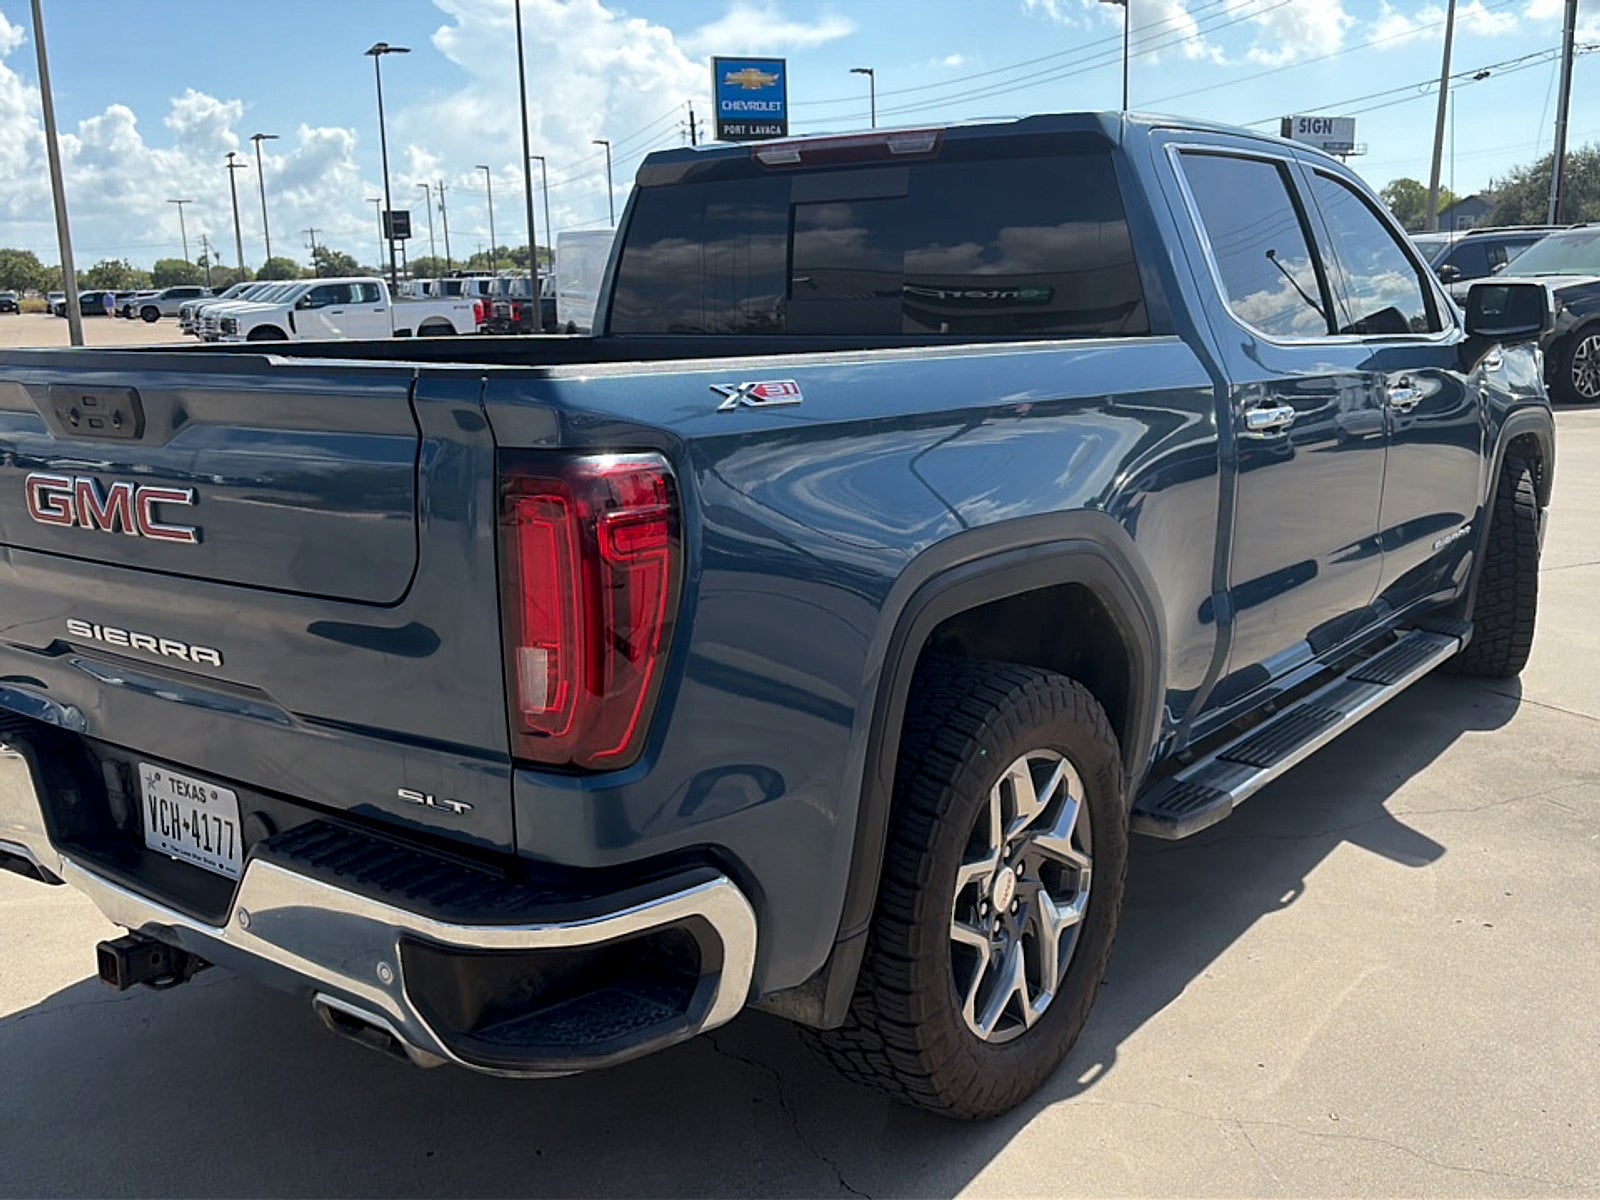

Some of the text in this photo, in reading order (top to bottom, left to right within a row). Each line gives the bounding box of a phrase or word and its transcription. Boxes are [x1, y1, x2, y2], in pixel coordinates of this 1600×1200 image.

[721, 100, 783, 112] CHEVROLET
[723, 124, 782, 135] PORT LAVACA
[1298, 117, 1333, 135] SIGN
[25, 472, 200, 544] GMC
[66, 617, 223, 667] SIERRA
[168, 777, 207, 803] TEXAS
[398, 787, 473, 814] SLT
